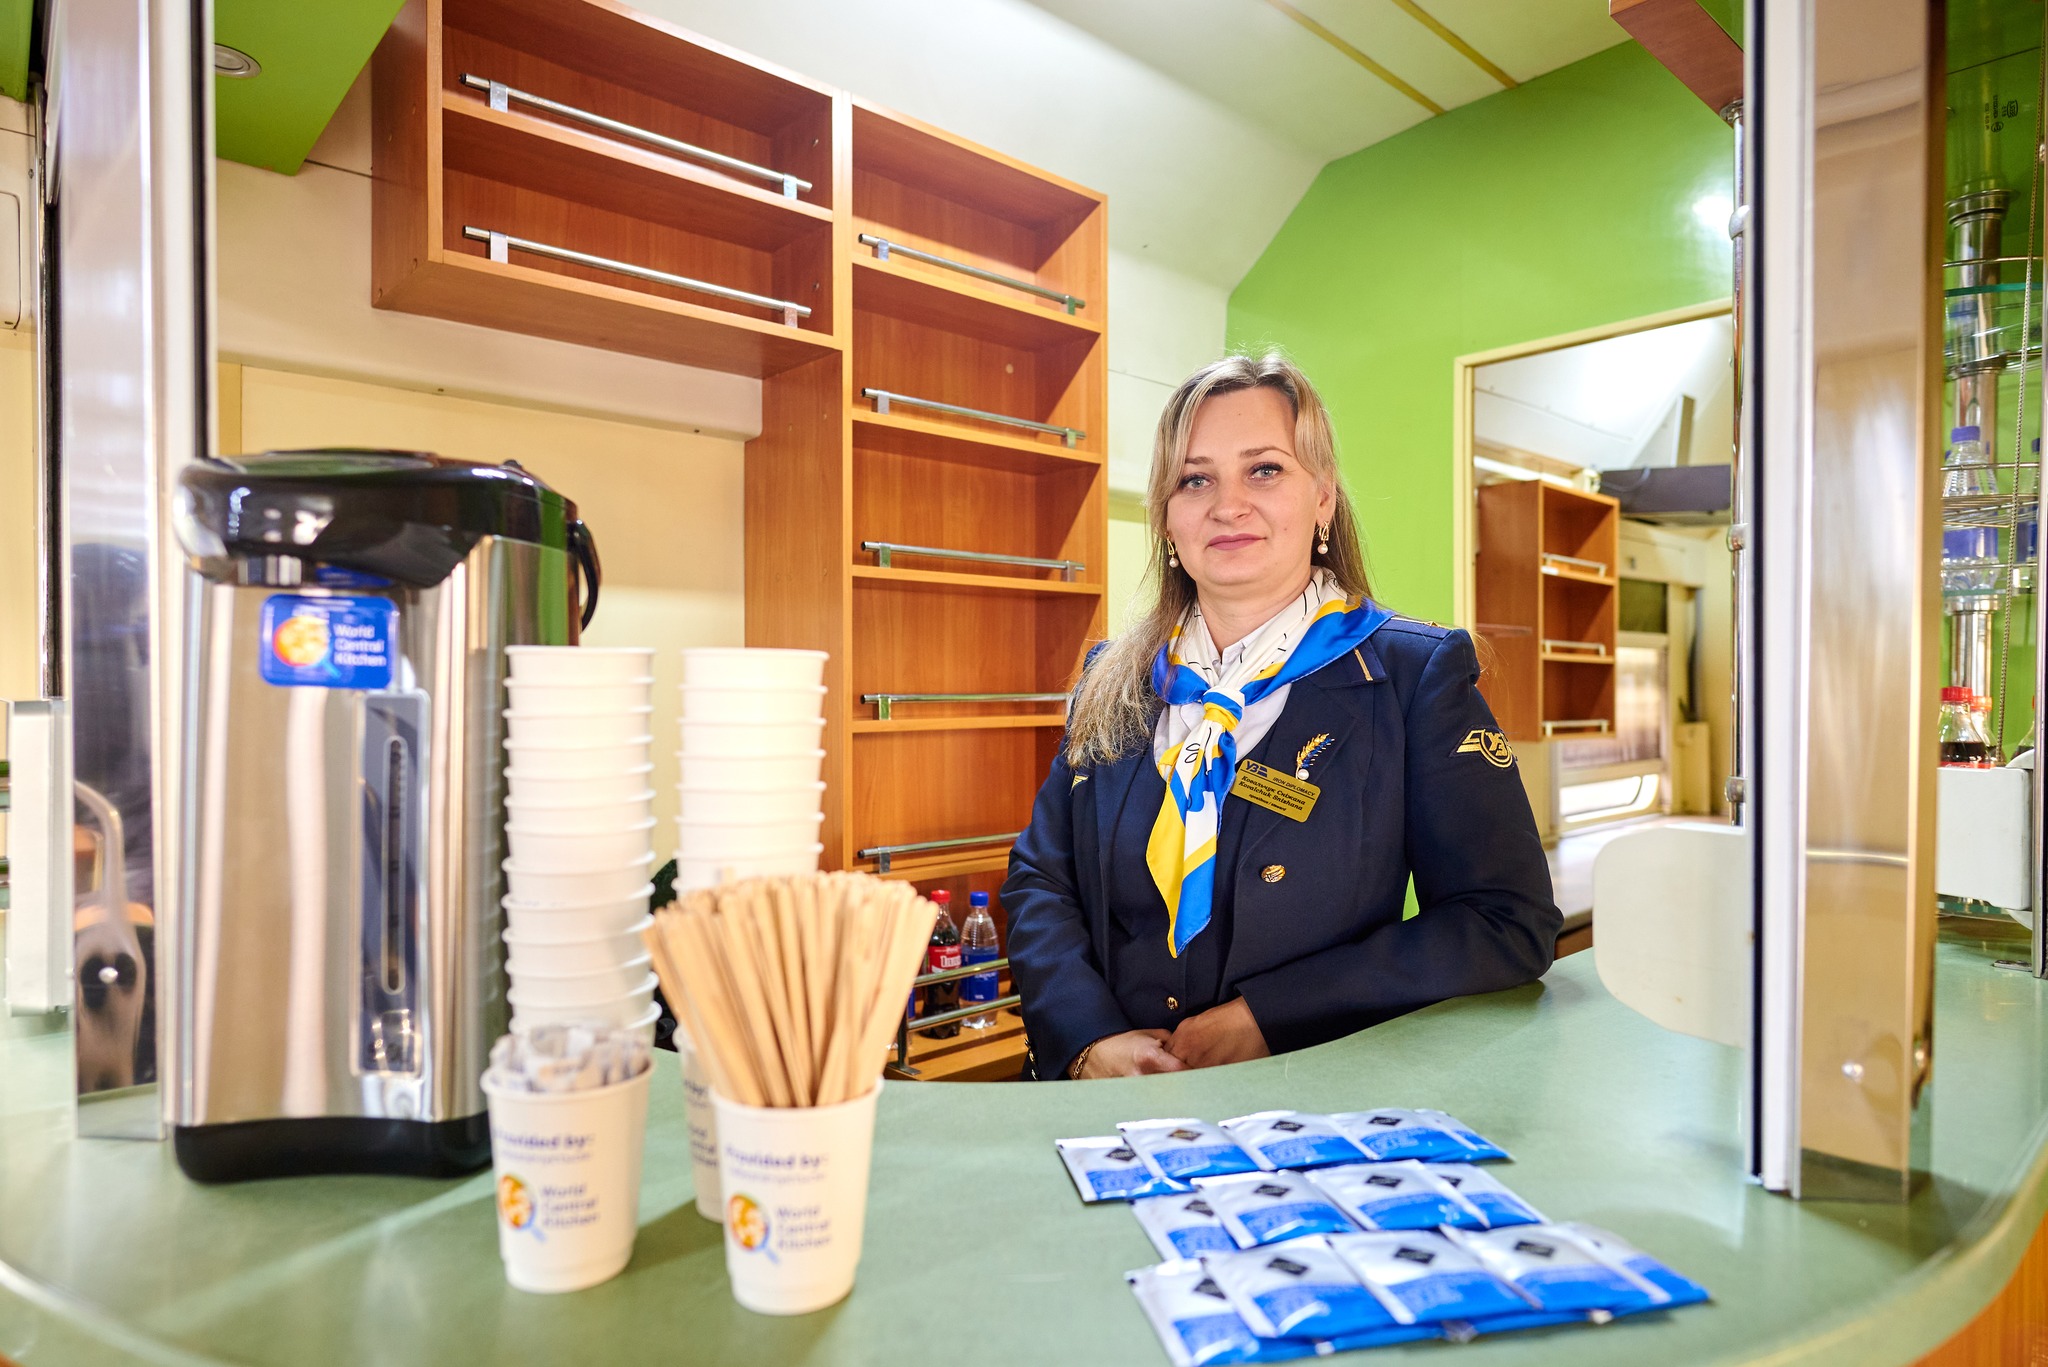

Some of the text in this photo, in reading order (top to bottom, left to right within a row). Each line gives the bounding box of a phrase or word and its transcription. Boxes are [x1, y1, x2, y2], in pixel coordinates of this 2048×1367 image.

[333, 624, 375, 639] World
[335, 638, 385, 653] Central
[334, 652, 387, 667] Kitchen
[1273, 777, 1315, 797] IRON DIPLOMACY
[1239, 781, 1303, 811] Kovalchuk Snizhana
[541, 1184, 587, 1198] World
[776, 1204, 822, 1220] World
